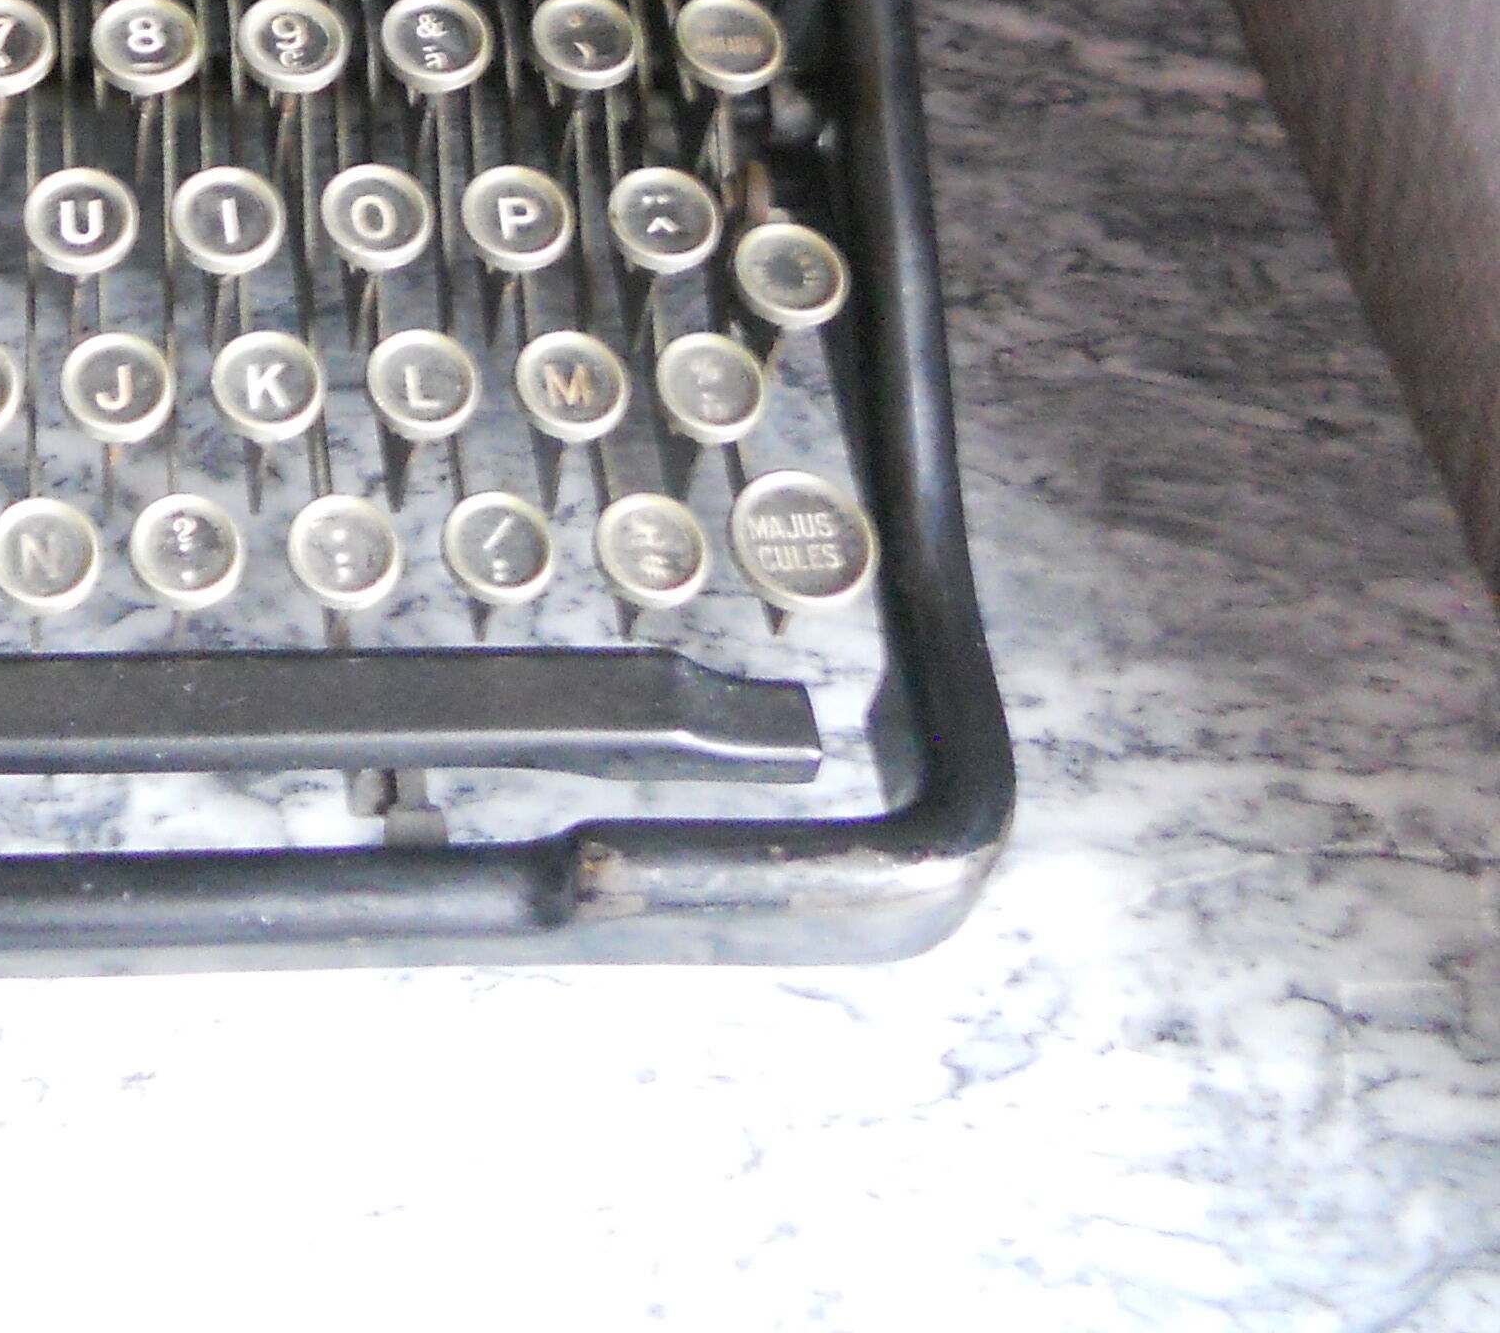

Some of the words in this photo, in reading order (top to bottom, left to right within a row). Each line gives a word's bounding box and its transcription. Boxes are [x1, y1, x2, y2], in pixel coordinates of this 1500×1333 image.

[127, 16, 166, 53] 8
[271, 15, 309, 50] 9
[59, 198, 104, 245] U
[221, 197, 241, 244] I
[350, 194, 398, 239] O
[497, 196, 542, 240] P
[94, 364, 134, 411] J
[245, 362, 290, 411] K
[403, 364, 441, 409] L
[543, 362, 595, 409] M
[748, 513, 834, 540] MAJUS
[20, 532, 63, 581] N
[757, 541, 841, 572] CULES
